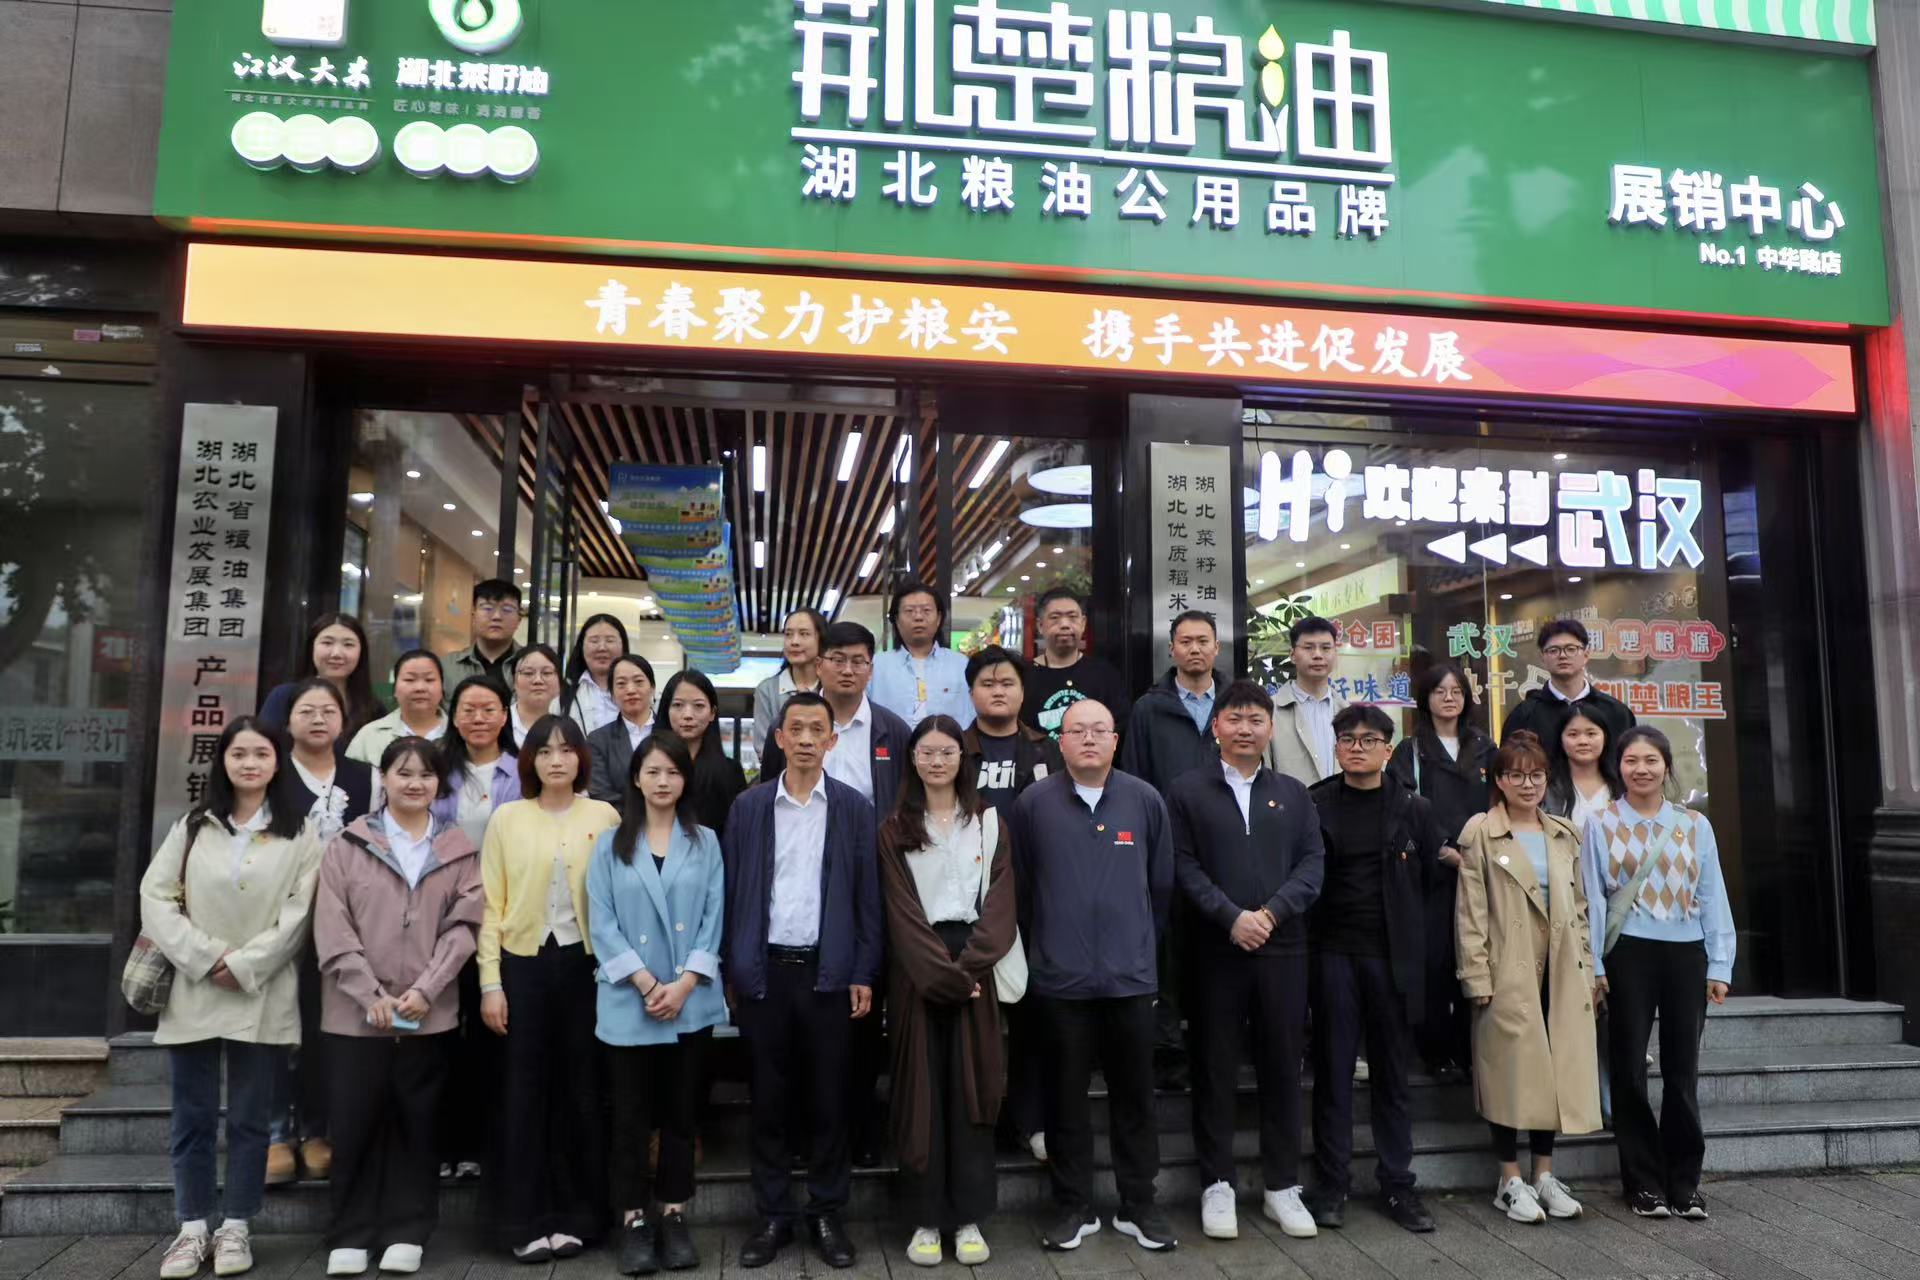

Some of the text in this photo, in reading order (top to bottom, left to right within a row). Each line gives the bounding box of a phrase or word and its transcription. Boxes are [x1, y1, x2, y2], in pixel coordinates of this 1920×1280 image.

[395, 57, 549, 94] 湖北菜籽油
[800, 143, 1390, 241] 湖北粮油公用品牌
[1608, 163, 1846, 242] 展销中心
[1699, 243, 1842, 276] No.1 中华路店
[584, 279, 1473, 384] 青春聚力护粮安 携手共进促发展
[183, 440, 223, 637] 湖北农业发展集团
[1258, 449, 1353, 542] Hi
[1167, 475, 1190, 633] 湖北优质稻米
[1195, 477, 1217, 620] 湖北菜籽油
[1446, 622, 1518, 659] 武汉
